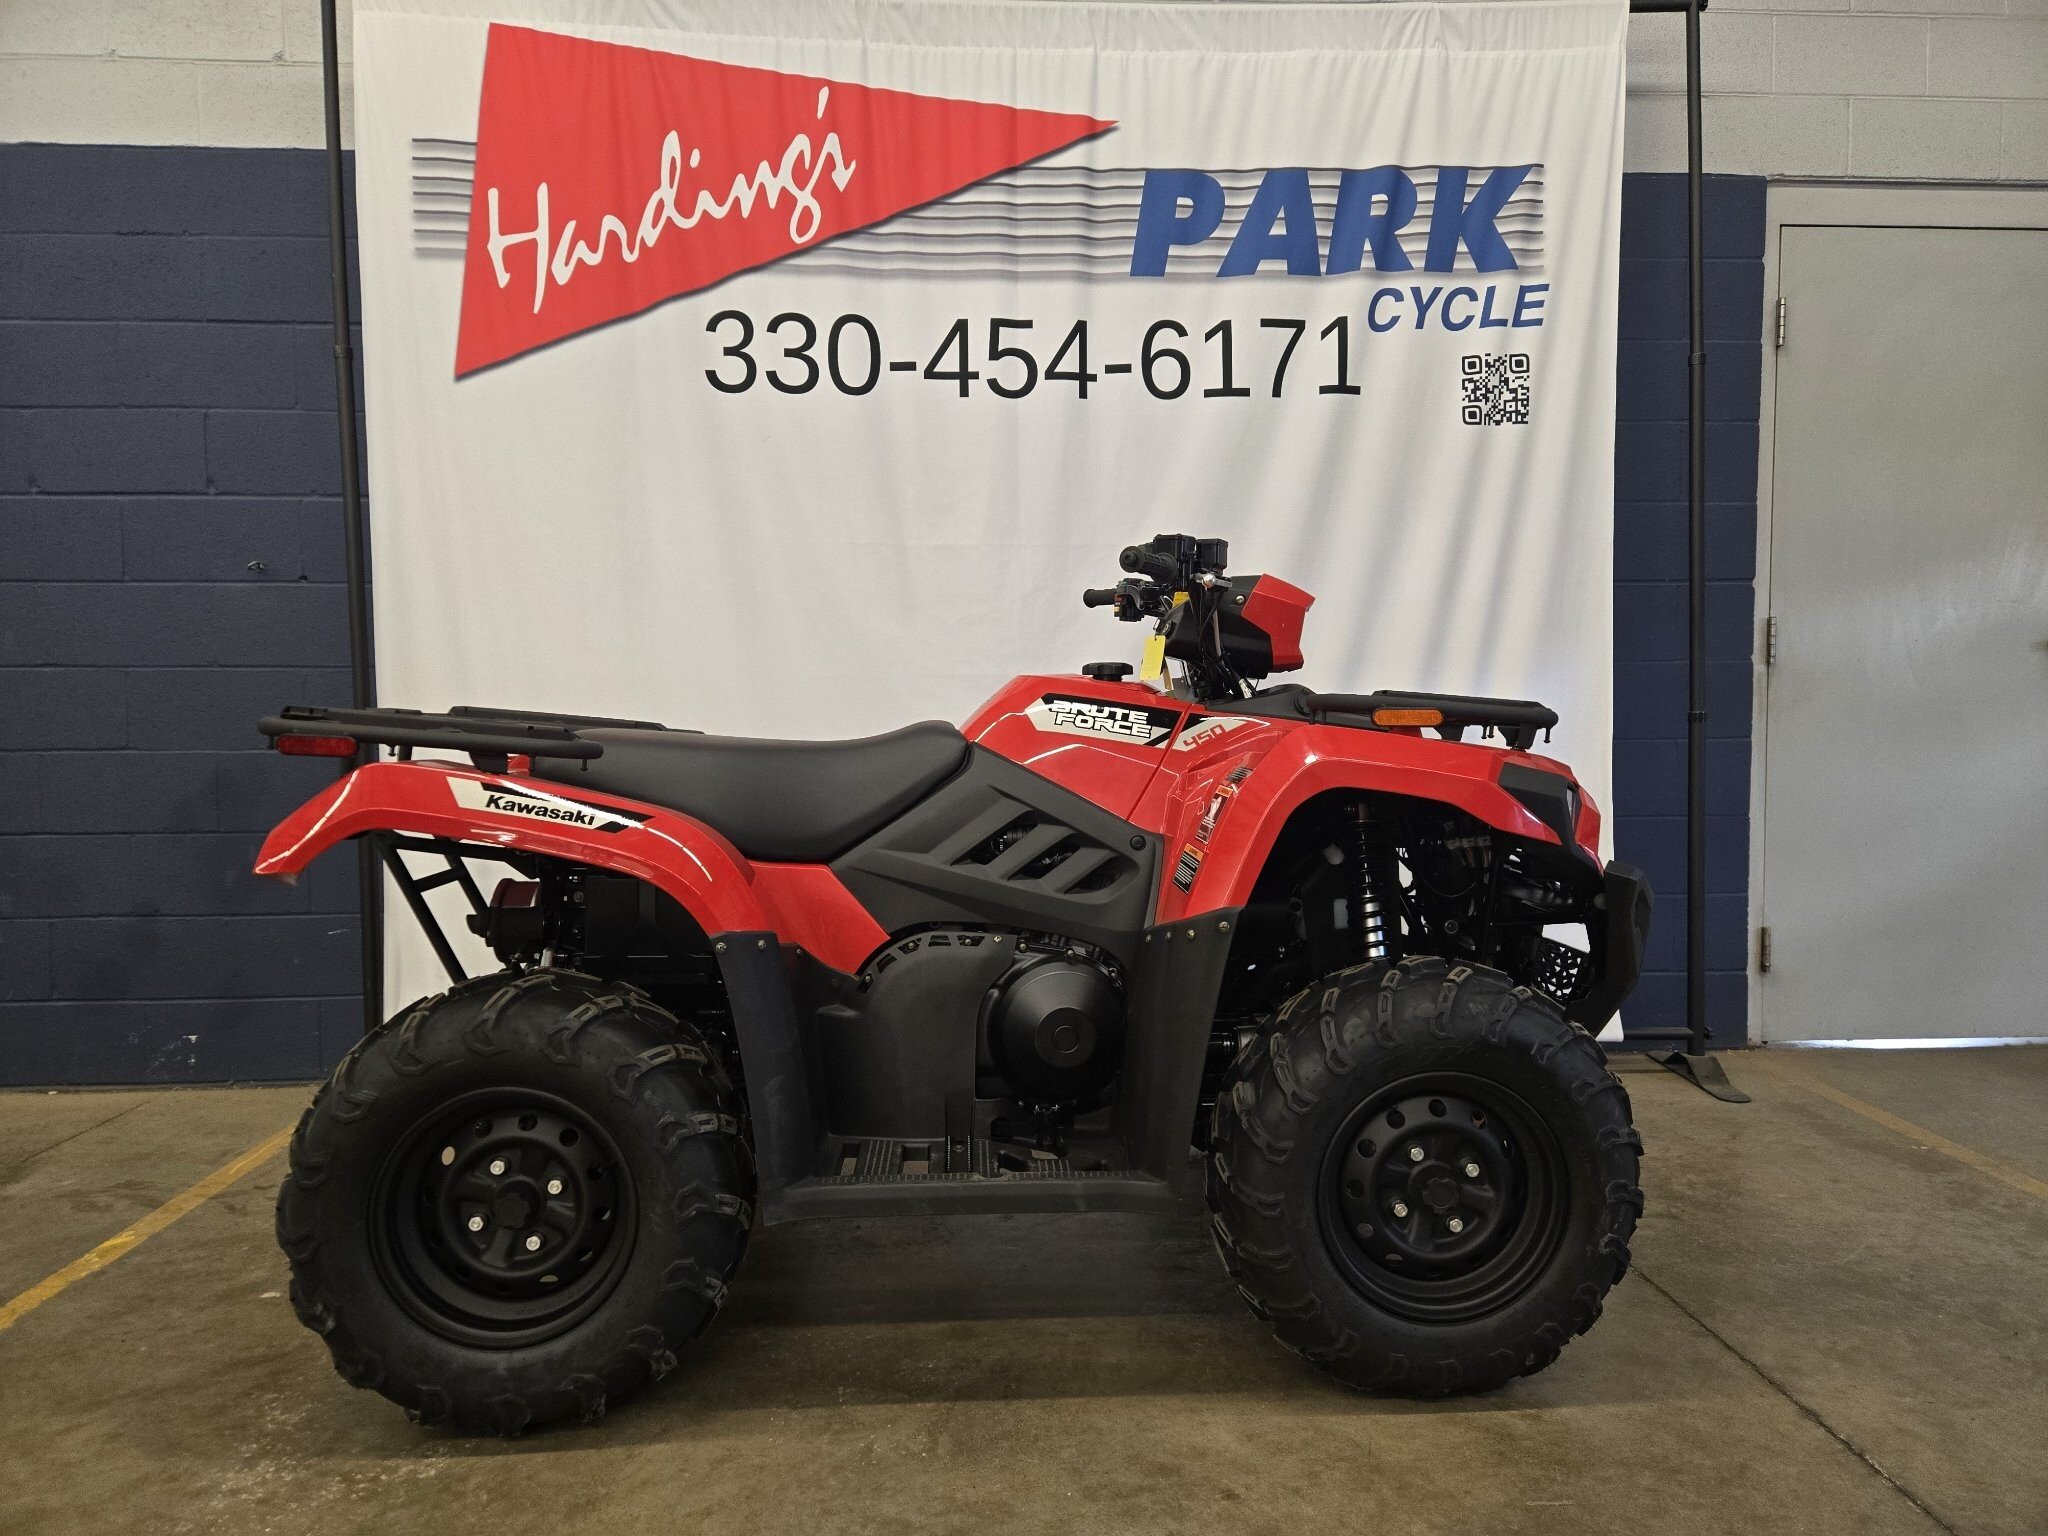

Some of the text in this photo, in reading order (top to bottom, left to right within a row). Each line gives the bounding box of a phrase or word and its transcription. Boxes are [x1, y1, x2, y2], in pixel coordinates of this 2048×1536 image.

[487, 86, 856, 314] Harding's
[1130, 165, 1533, 277] PARK
[1368, 284, 1549, 333] CYCLE
[704, 310, 1361, 400] 330-454-6171
[1050, 699, 1149, 724] BRUTE
[1054, 712, 1153, 738] FORCE
[1182, 723, 1228, 748] 450
[485, 794, 596, 826] Kawasaki
